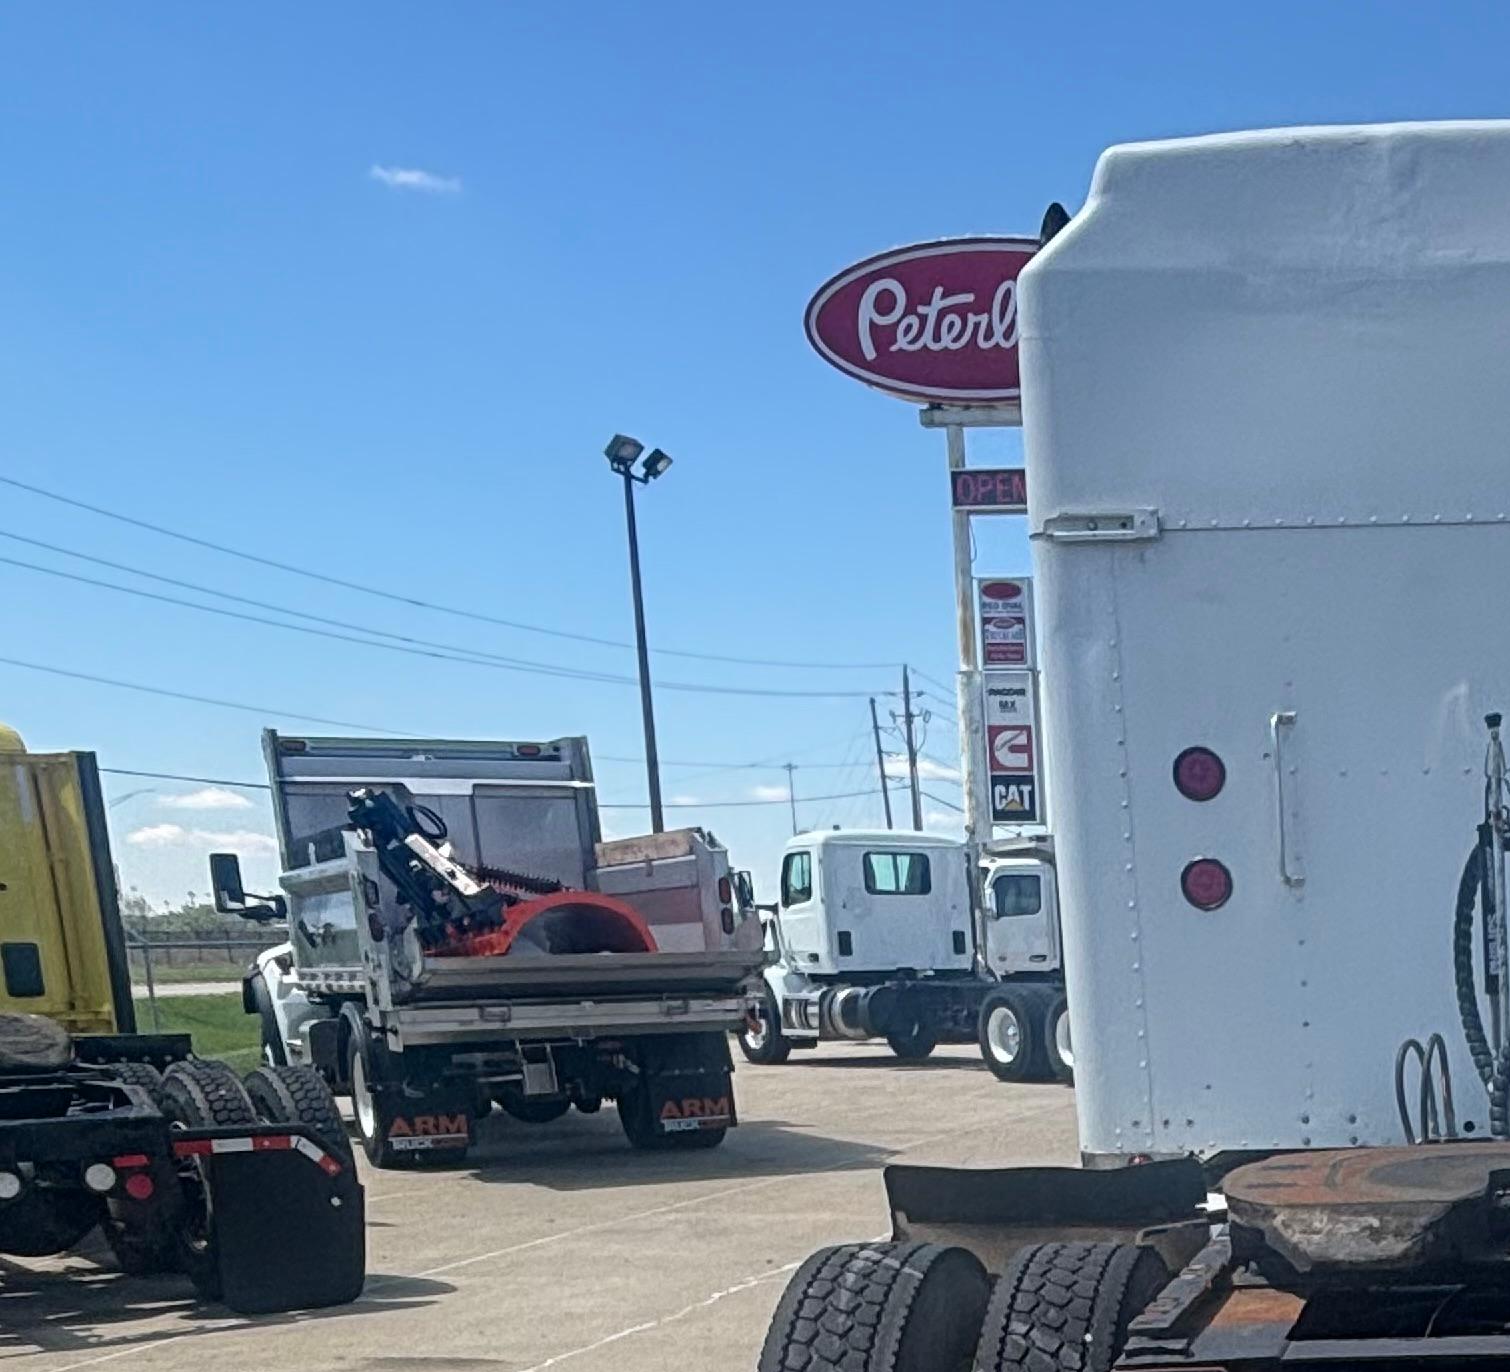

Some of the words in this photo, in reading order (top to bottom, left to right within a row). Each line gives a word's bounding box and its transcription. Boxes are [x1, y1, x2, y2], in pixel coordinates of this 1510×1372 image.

[956, 473, 1027, 502] OPEN
[994, 785, 1031, 811] CAT
[661, 1097, 730, 1118] ARM
[388, 1114, 467, 1137] ARM
